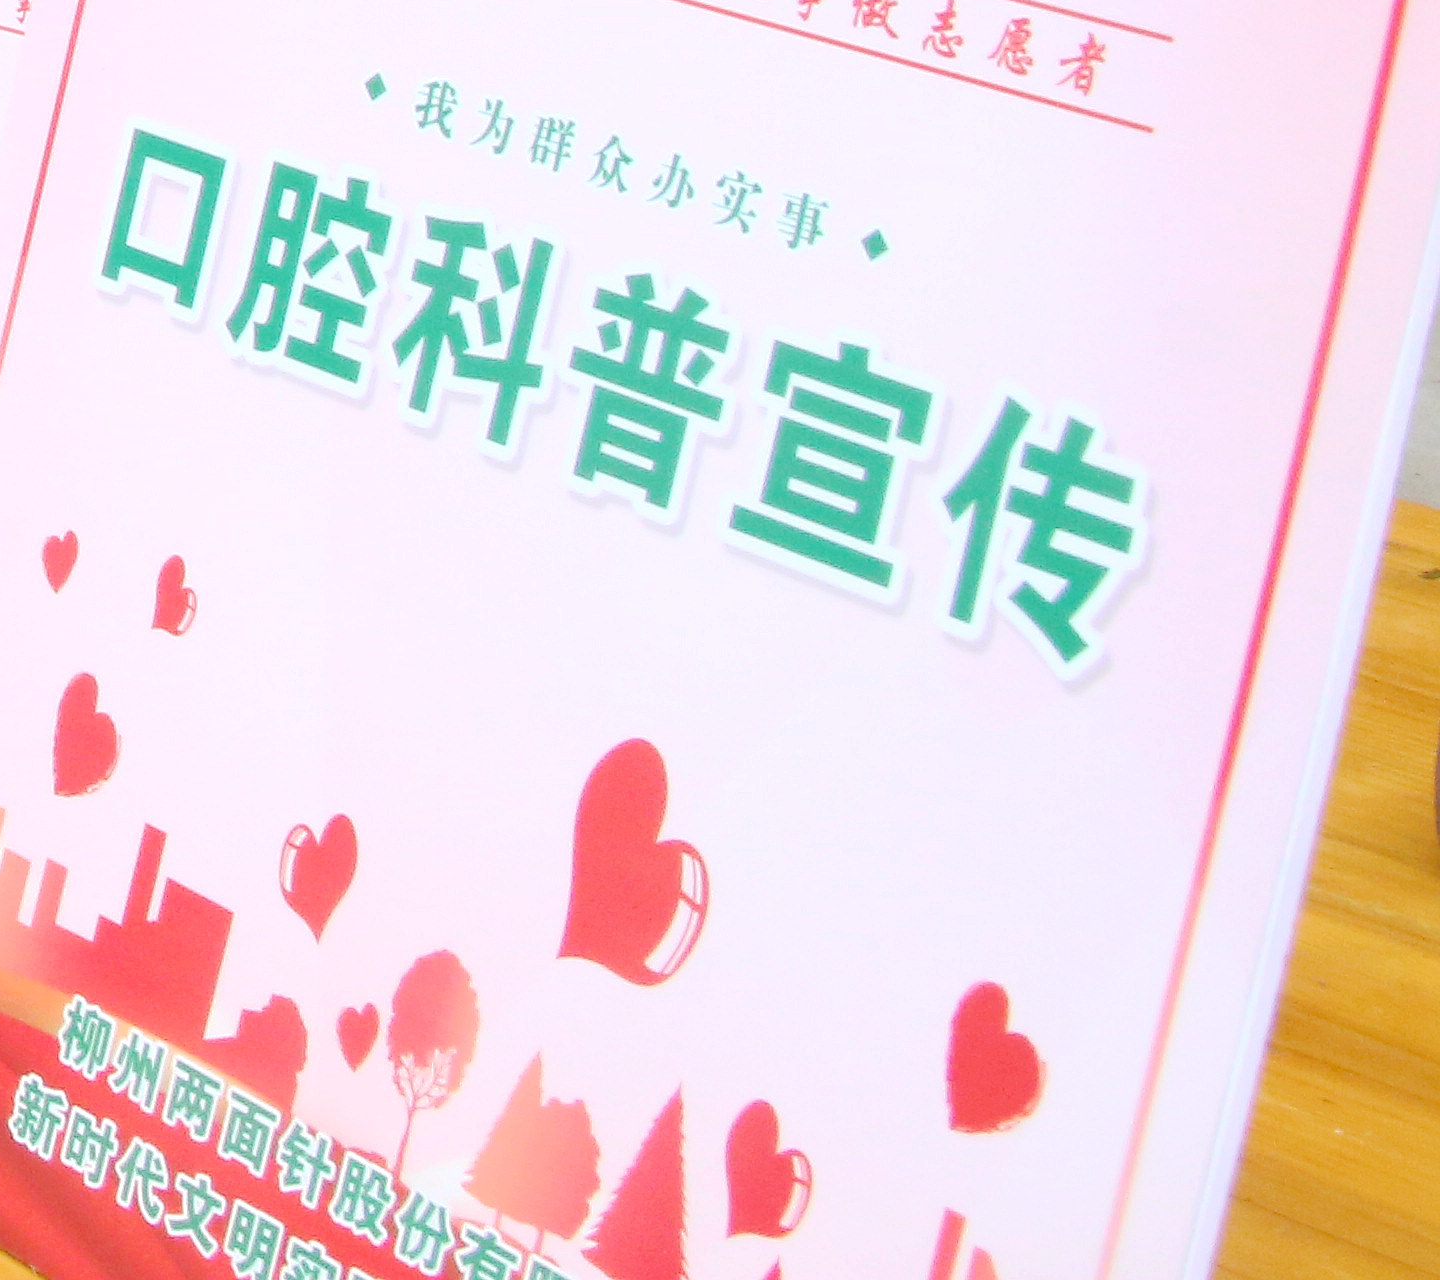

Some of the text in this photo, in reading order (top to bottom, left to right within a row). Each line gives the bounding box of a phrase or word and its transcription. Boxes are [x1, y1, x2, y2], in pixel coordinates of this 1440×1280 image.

[413, 80, 828, 252] 我为群众办实事
[99, 127, 1138, 666] 口腔科普宣传
